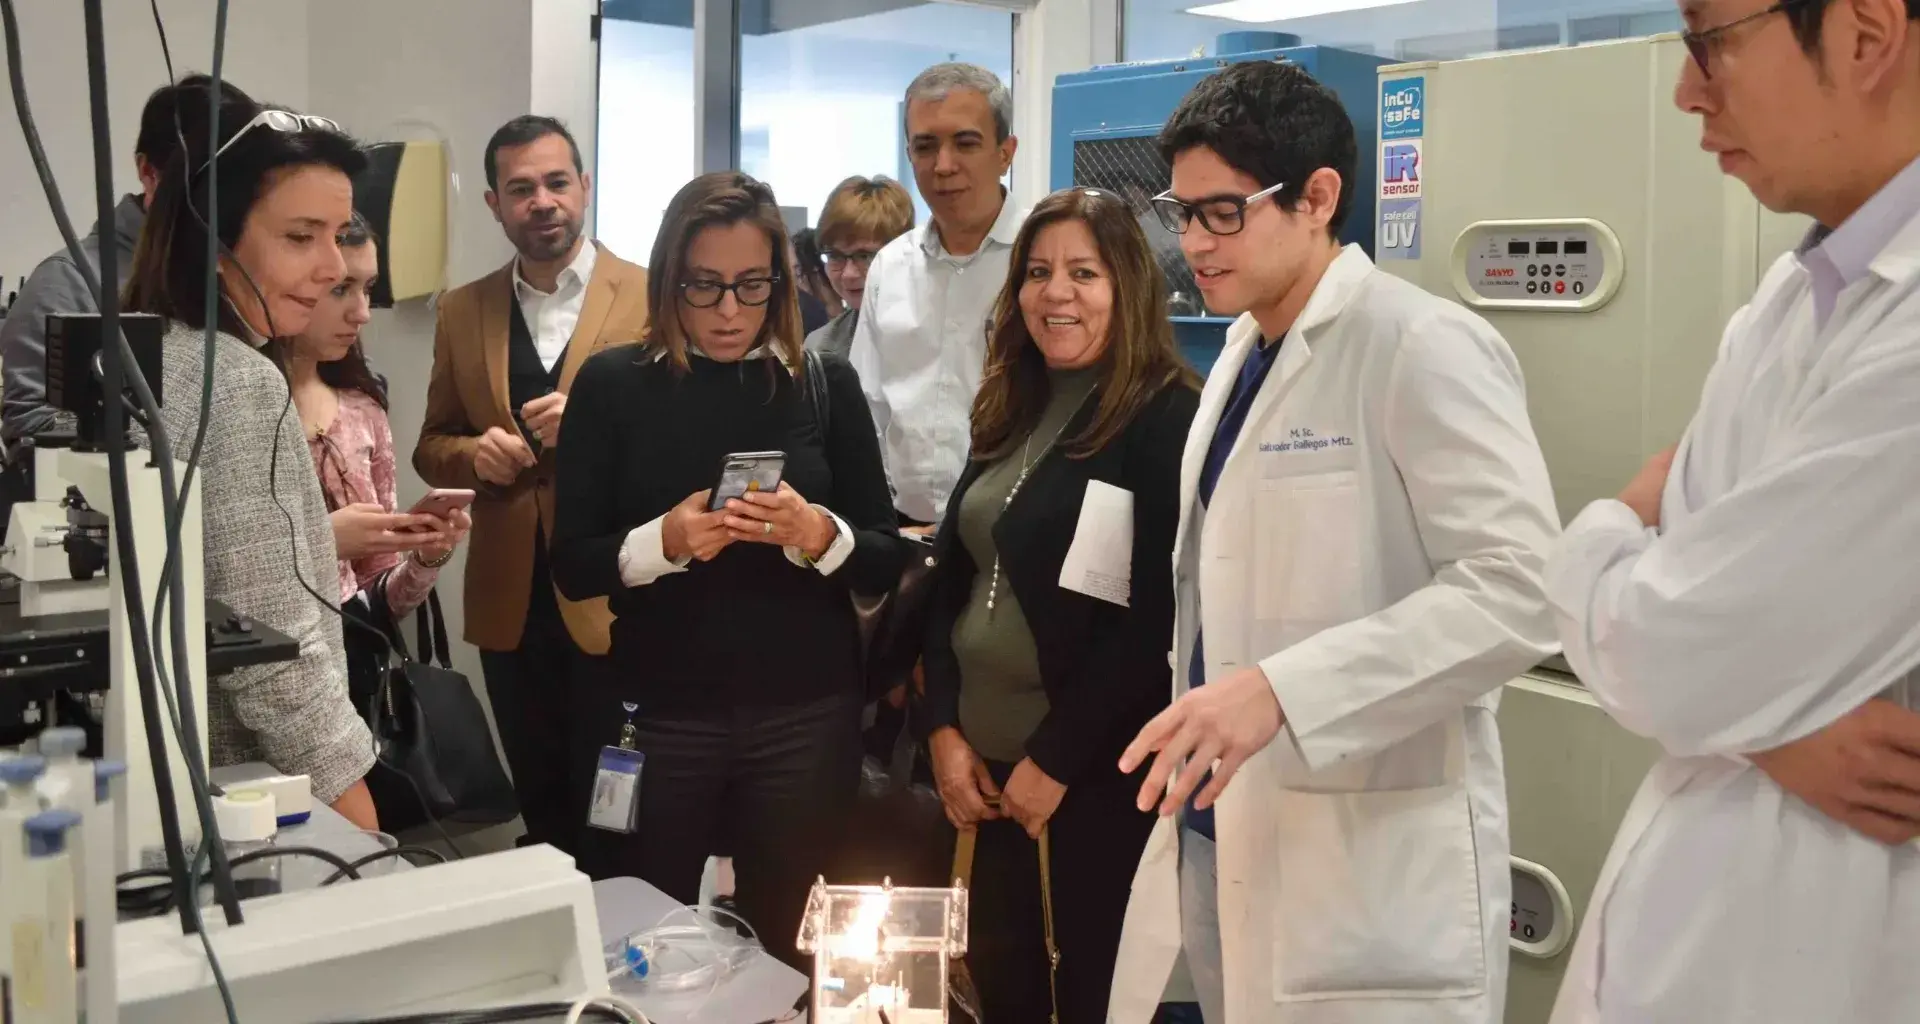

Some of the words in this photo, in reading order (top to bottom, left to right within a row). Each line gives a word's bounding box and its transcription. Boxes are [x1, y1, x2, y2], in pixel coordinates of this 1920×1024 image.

[1383, 144, 1419, 183] IR
[1383, 184, 1419, 195] sensor
[1383, 211, 1401, 221] safe
[1383, 222, 1417, 248] UV
[1485, 268, 1514, 277] SANYO
